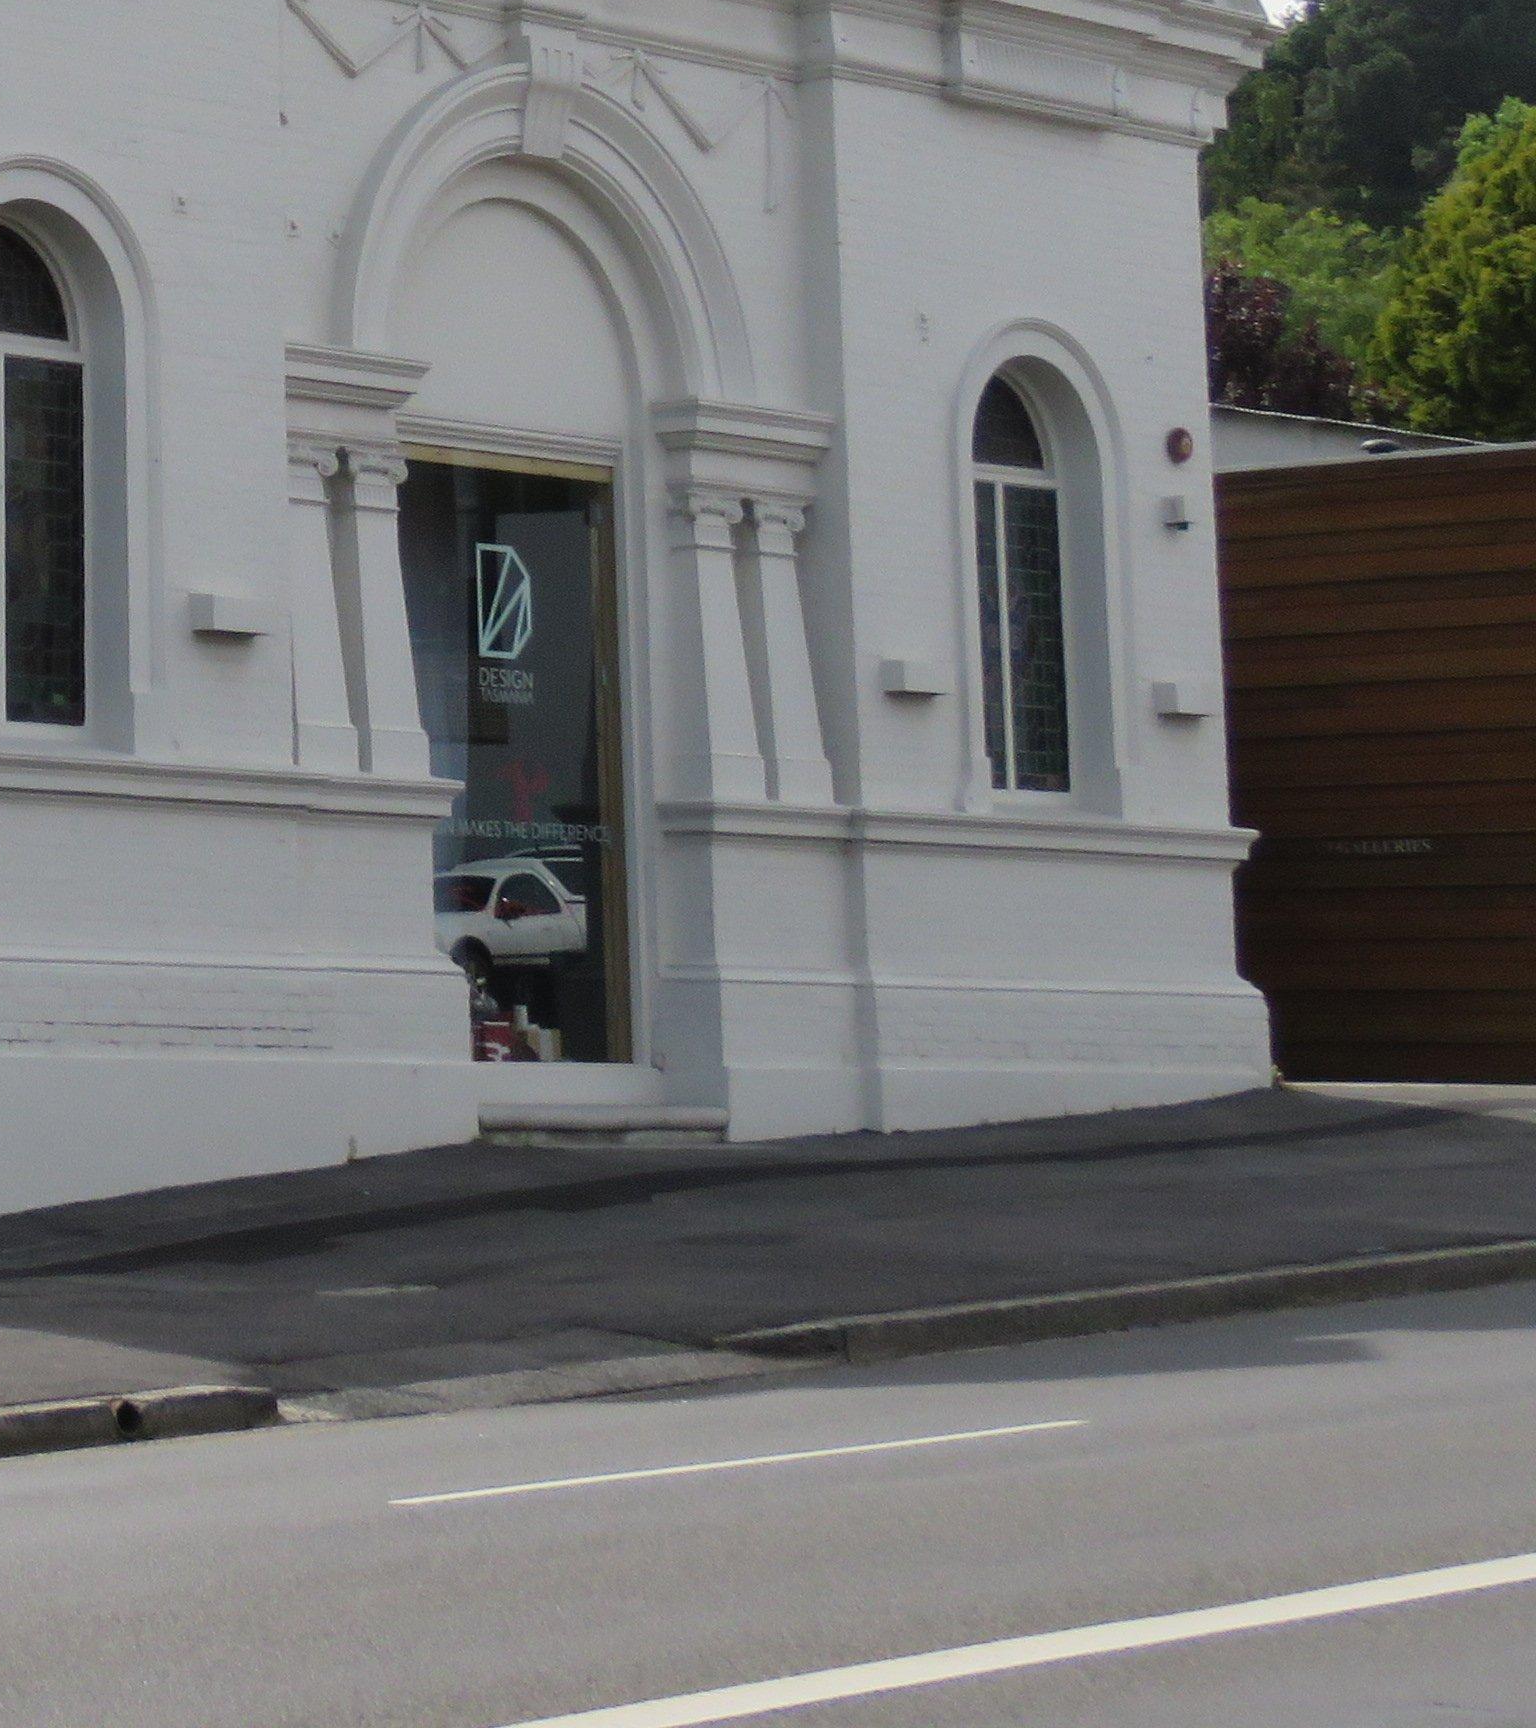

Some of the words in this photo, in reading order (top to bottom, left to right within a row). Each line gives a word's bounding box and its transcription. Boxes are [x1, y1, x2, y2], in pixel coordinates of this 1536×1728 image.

[479, 666, 534, 689] DESIGN
[459, 819, 502, 838] MAKES
[504, 821, 528, 839] THE
[531, 822, 611, 843] DIFFERENCE
